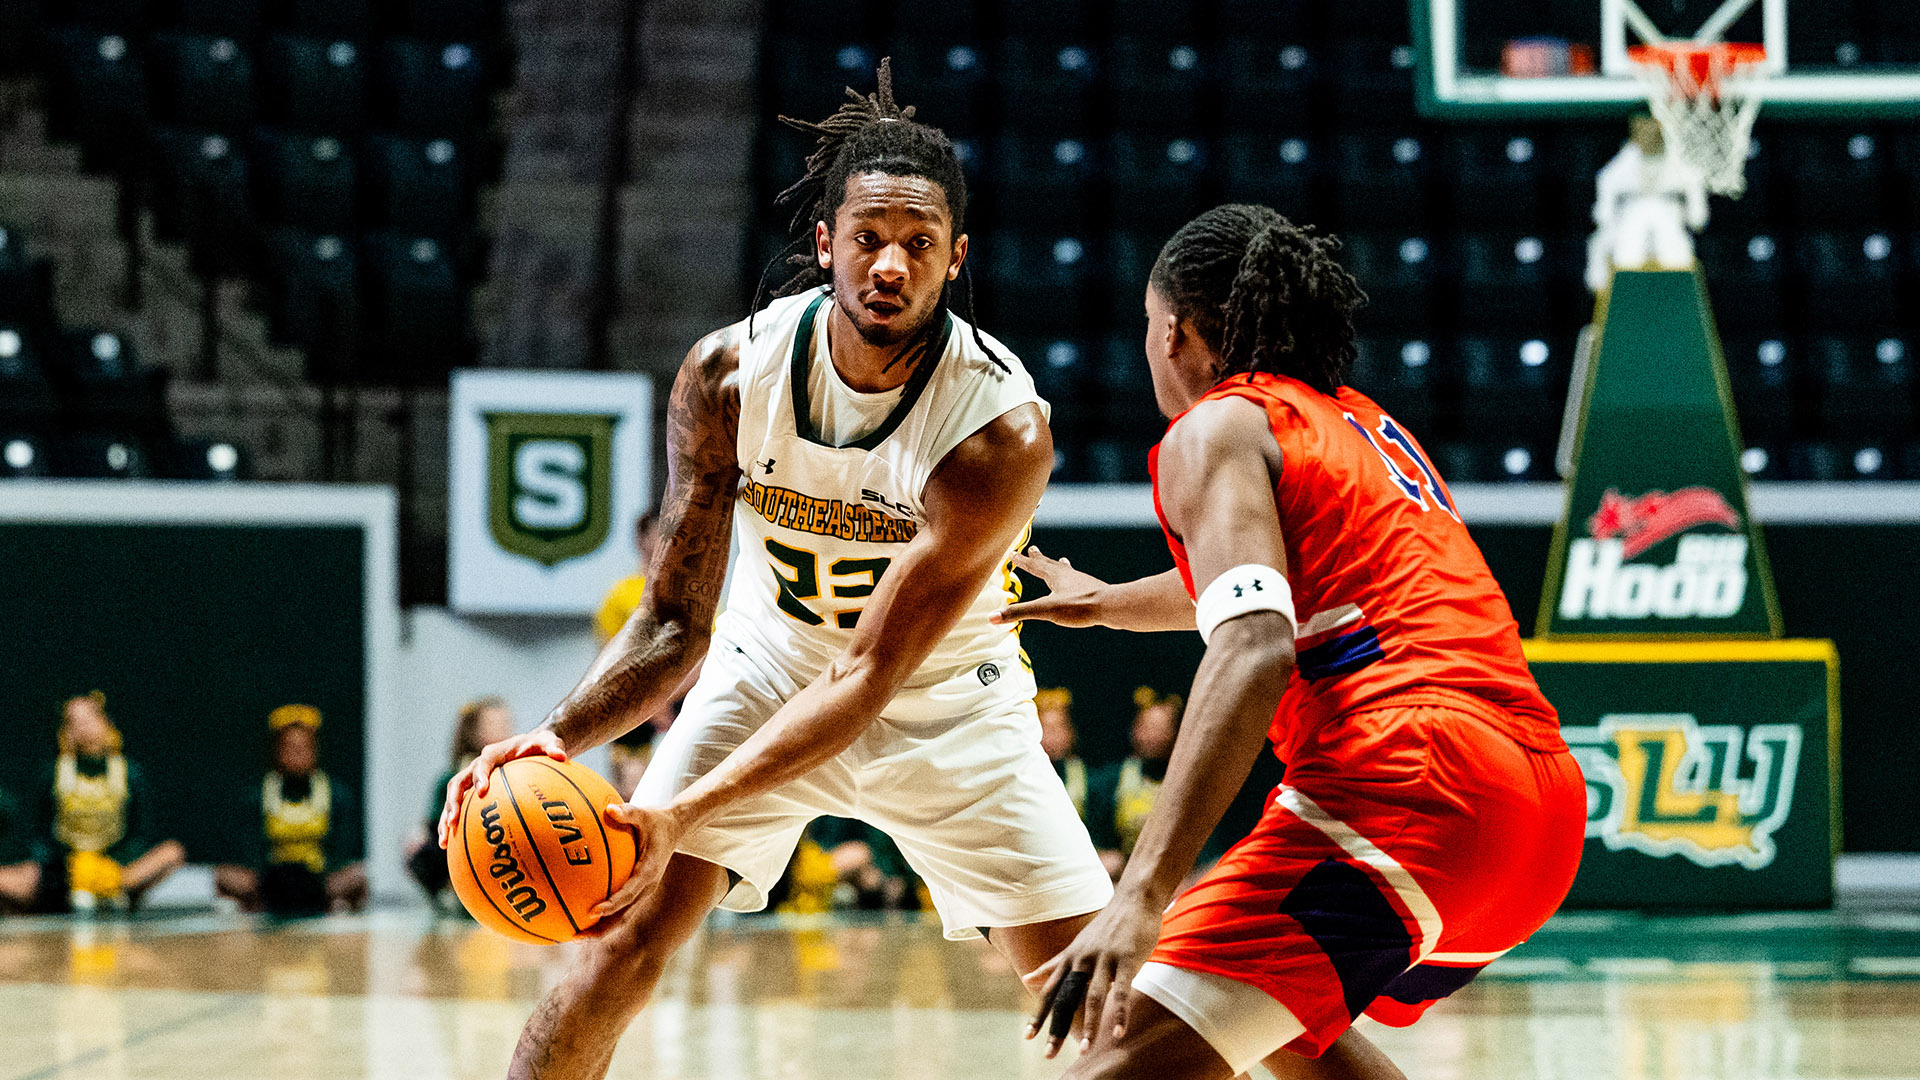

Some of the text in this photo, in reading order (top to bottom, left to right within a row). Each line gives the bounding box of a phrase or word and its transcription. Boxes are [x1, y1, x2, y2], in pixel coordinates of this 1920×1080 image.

[514, 439, 587, 530] S
[1343, 412, 1462, 524] 11
[479, 800, 548, 923] Wilson
[542, 800, 592, 866] EVO
